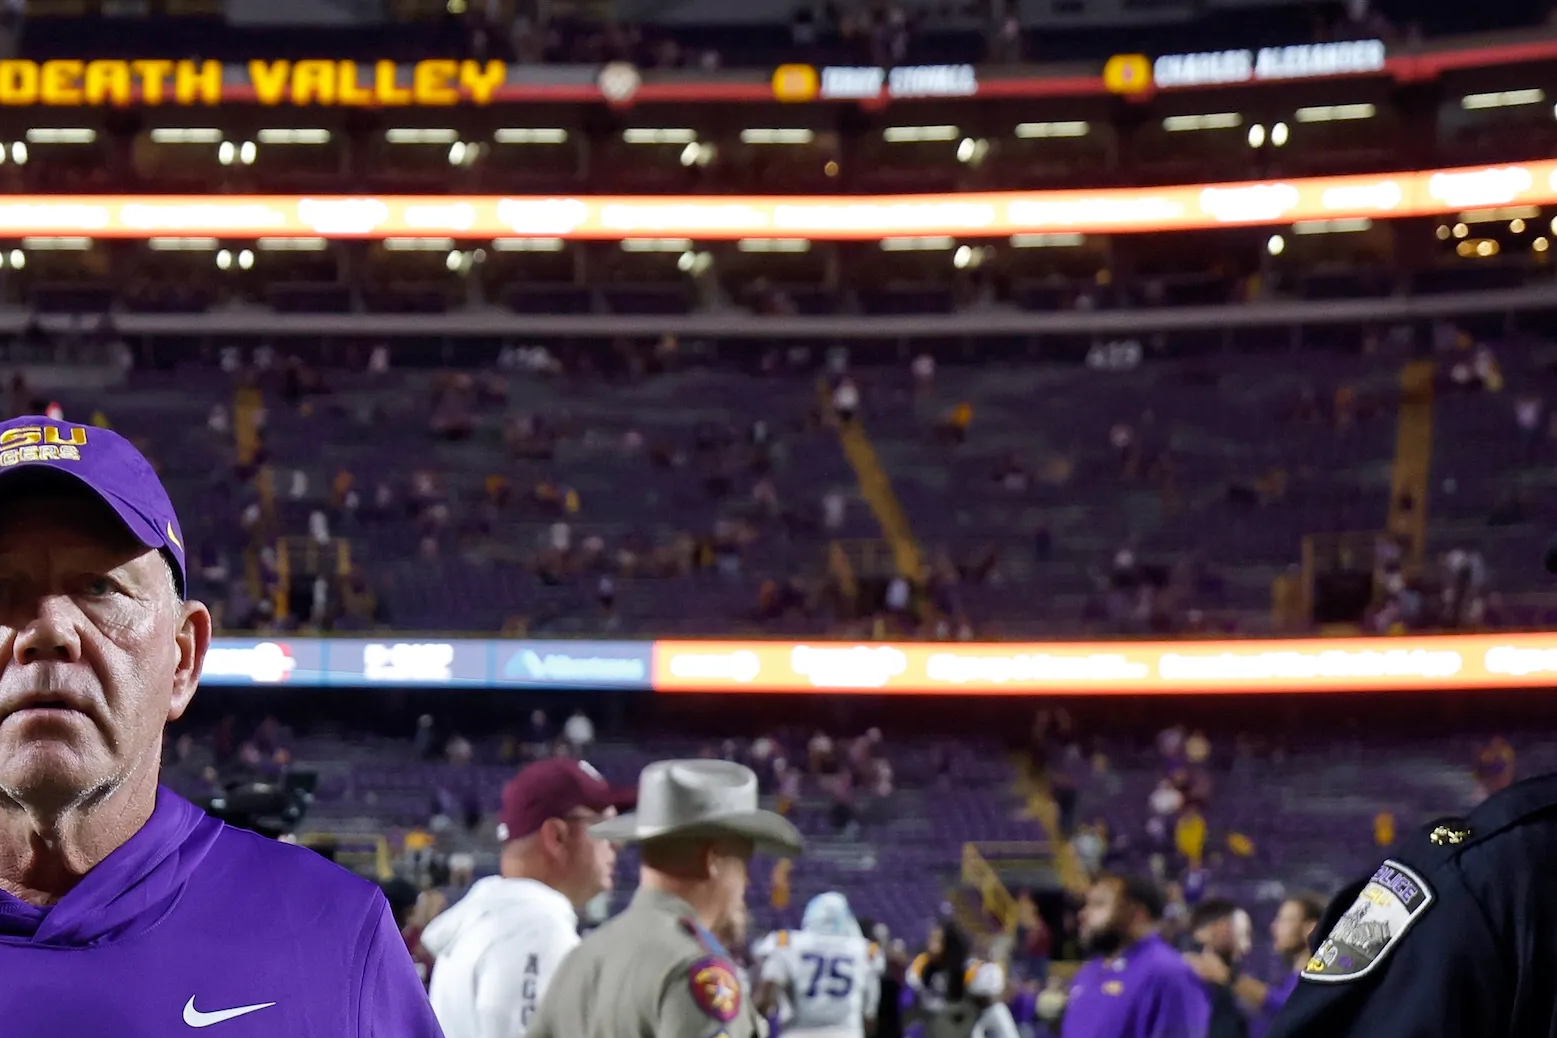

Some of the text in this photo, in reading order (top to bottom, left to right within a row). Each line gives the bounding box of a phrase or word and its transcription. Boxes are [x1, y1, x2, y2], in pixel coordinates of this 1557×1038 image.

[248, 59, 508, 106] VALLEY
[1369, 864, 1418, 904] OLICE
[801, 952, 853, 998] 75
